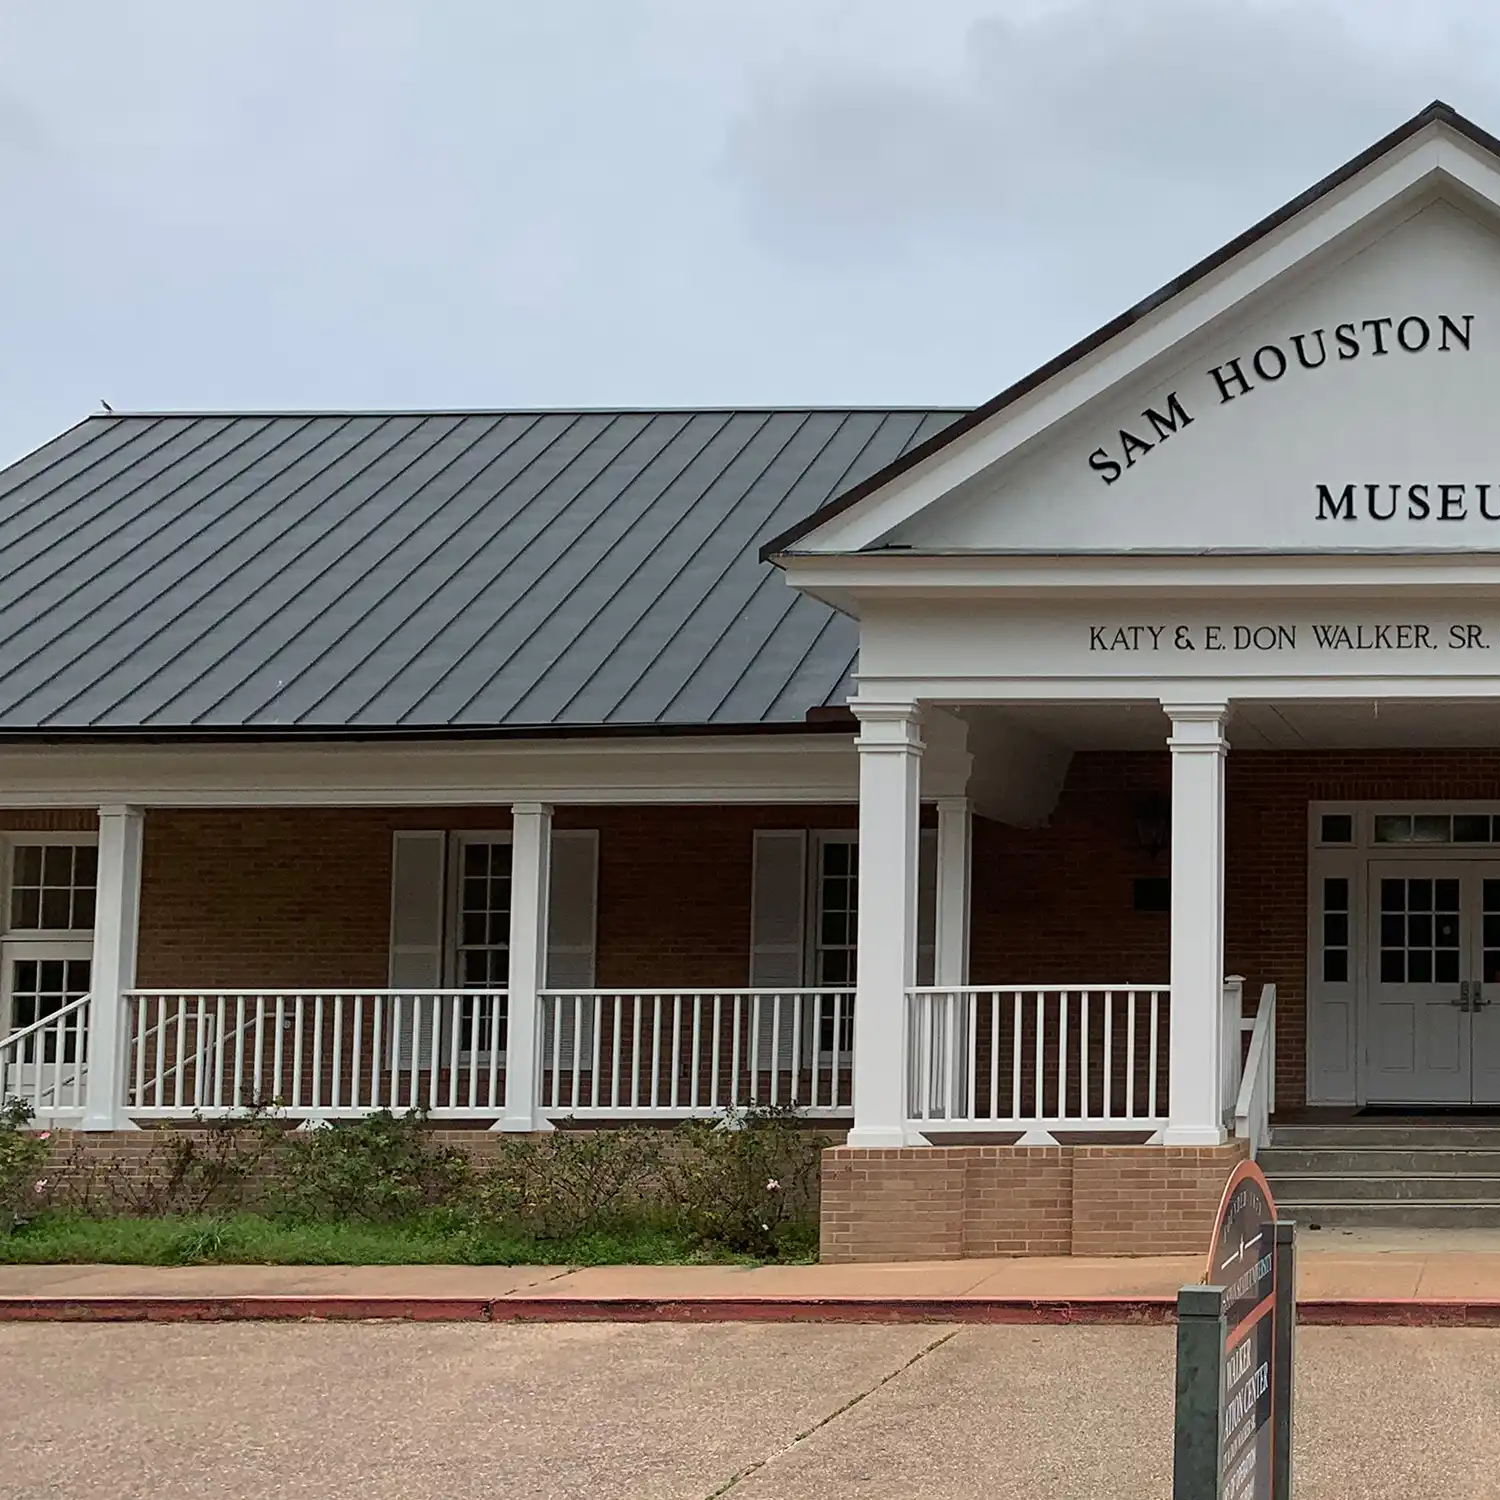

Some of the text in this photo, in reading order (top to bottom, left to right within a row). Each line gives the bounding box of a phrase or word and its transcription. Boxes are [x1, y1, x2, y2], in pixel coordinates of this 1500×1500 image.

[1088, 392, 1194, 485] SAM
[1206, 315, 1475, 404] HOUSTON
[1089, 625, 1167, 650] KATY
[1174, 625, 1196, 650] &
[1233, 624, 1297, 650] DON
[1448, 624, 1490, 649] SR.
[1243, 1361, 1269, 1413] CENTER
